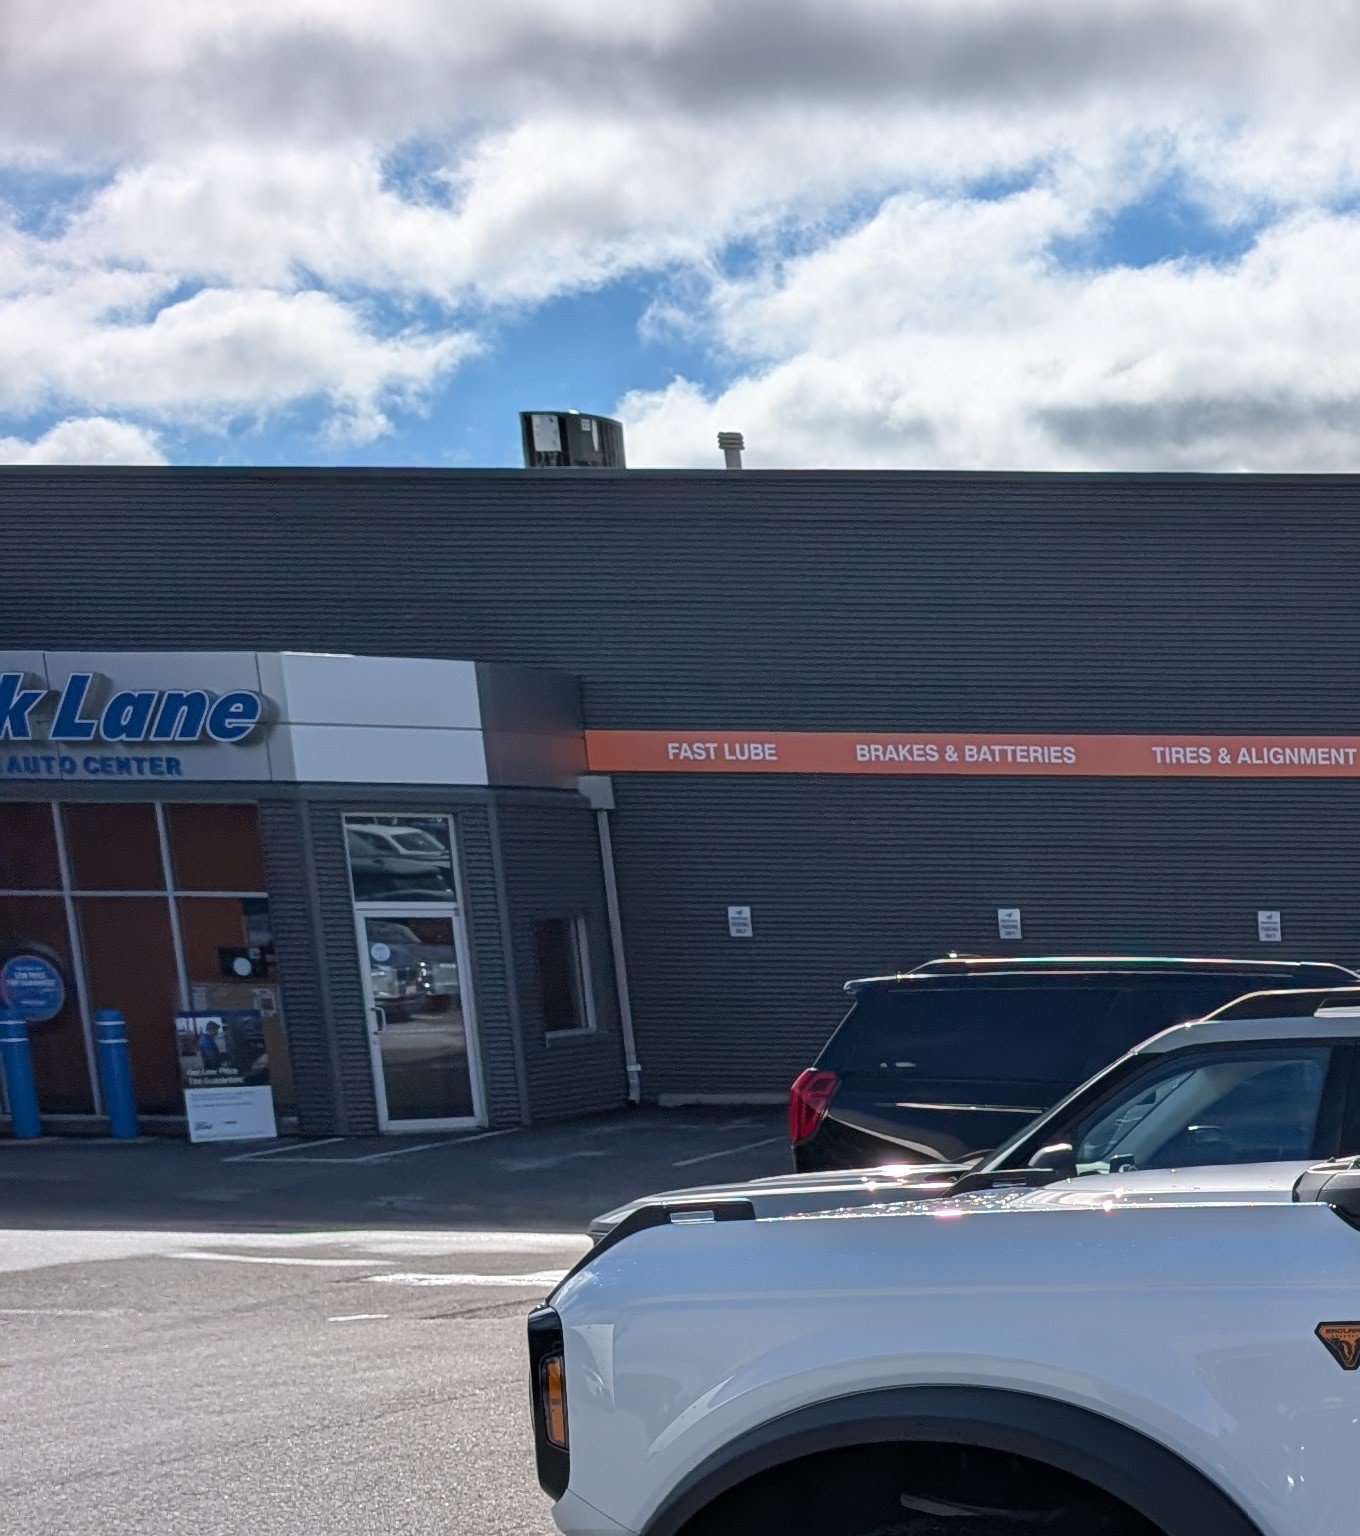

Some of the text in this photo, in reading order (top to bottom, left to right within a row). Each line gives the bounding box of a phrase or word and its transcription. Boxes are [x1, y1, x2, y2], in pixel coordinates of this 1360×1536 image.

[50, 672, 262, 742] Lane
[667, 742, 778, 761] FAST LUBE
[856, 744, 1077, 764] BRAKES & BATTERIES
[1151, 746, 1357, 765] TIRES & ALIGNMENT
[6, 755, 183, 777] AUTO CENTER
